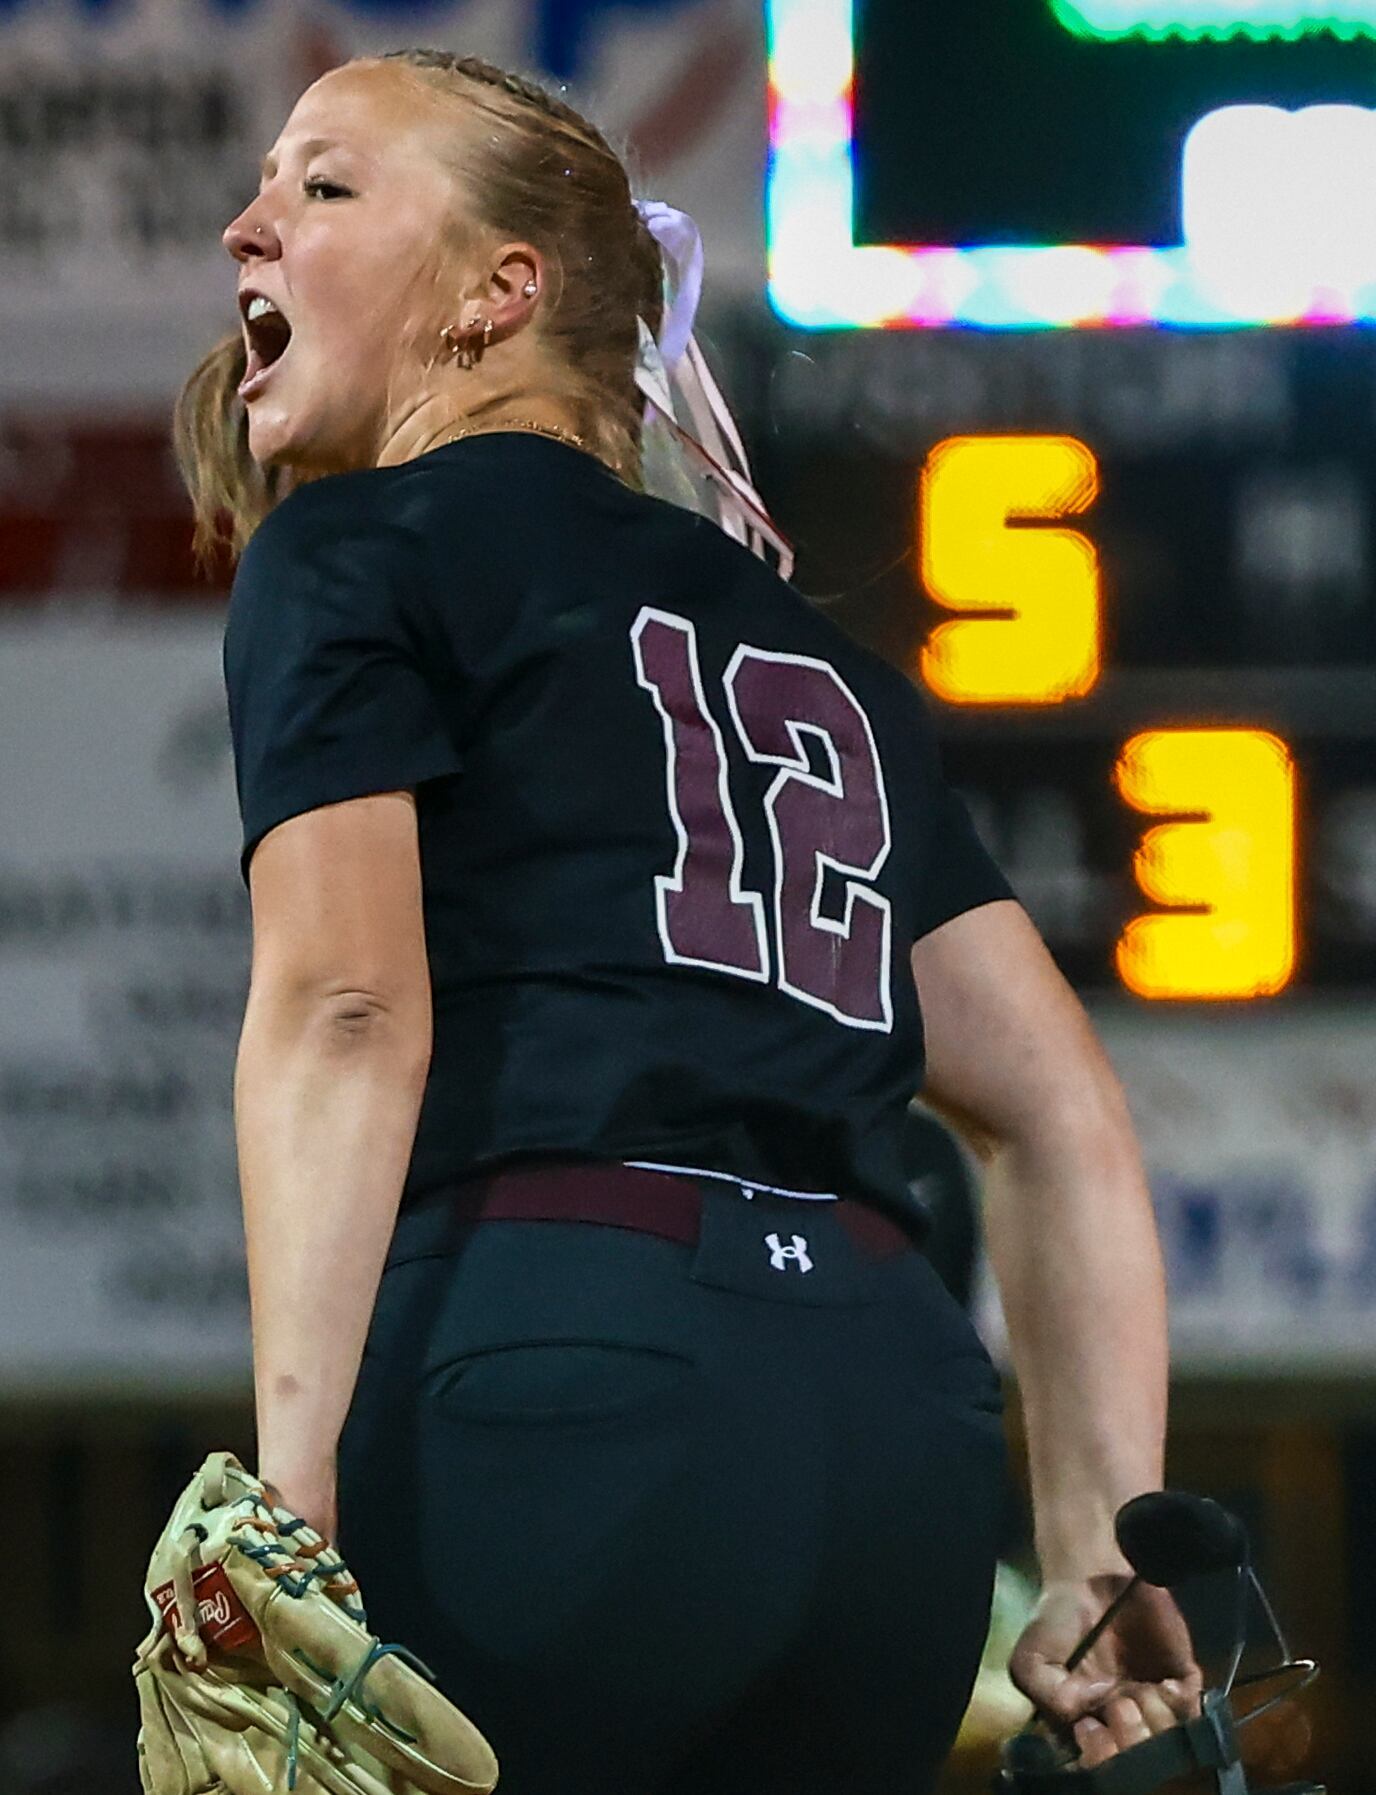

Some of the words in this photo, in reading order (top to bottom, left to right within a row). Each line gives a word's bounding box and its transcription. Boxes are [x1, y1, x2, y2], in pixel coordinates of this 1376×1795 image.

[921, 434, 1100, 704] 5
[630, 606, 892, 1033] 12
[1115, 728, 1295, 999] 3
